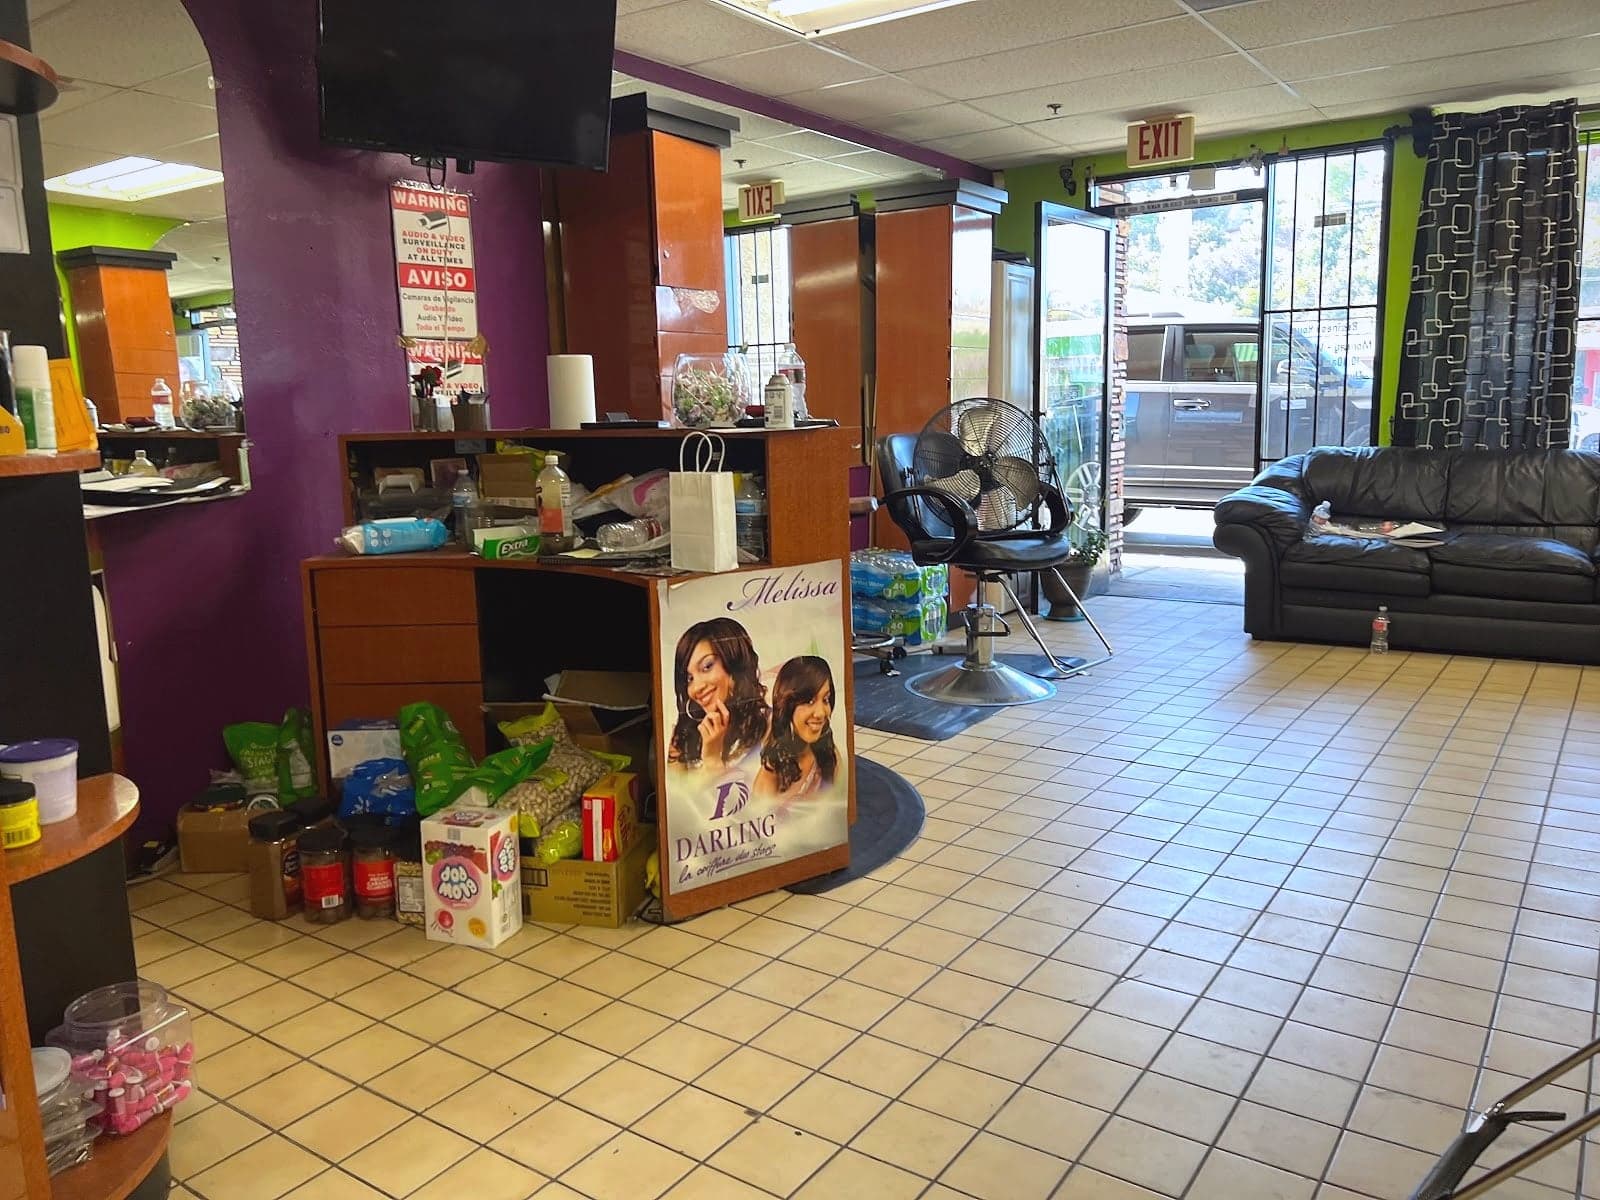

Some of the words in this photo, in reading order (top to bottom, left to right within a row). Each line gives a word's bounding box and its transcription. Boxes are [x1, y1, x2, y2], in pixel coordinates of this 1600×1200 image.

[1139, 121, 1182, 160] EXIT
[393, 190, 467, 212] WARNING
[402, 230, 429, 239] AUDIO
[440, 234, 465, 242] VIDEO
[402, 238, 465, 250] SURVEILLANCE
[431, 248, 453, 256] DUTY
[438, 256, 463, 264] TIMES
[407, 269, 467, 288] AVISO
[501, 539, 528, 554] Extra
[726, 570, 837, 611] Melissa
[675, 814, 775, 862] DARLING
